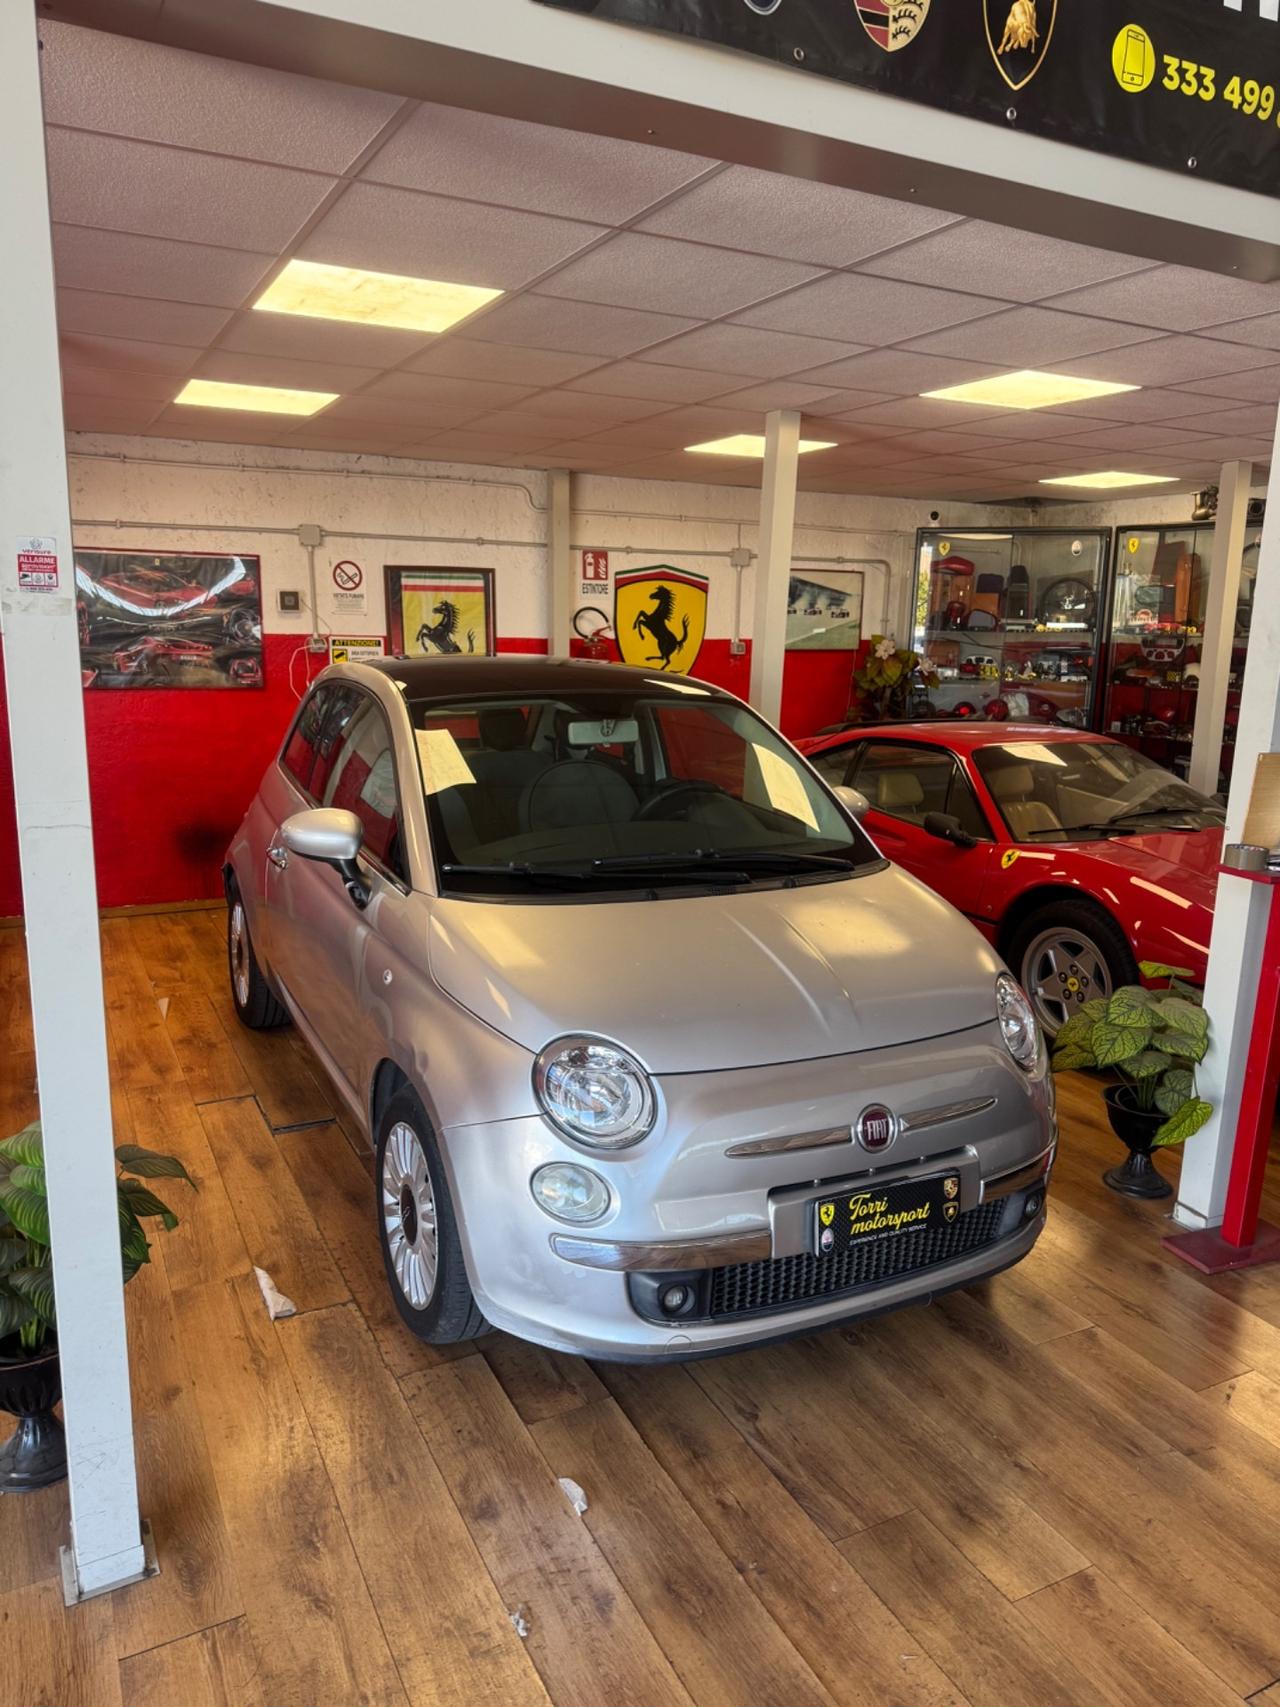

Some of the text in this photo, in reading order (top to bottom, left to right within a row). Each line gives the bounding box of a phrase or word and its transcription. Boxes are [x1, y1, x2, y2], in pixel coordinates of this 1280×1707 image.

[1162, 54, 1275, 120] 333 499
[866, 1119, 888, 1140] FIAT
[849, 1193, 889, 1221] Torri
[850, 1201, 931, 1235] motorsport
